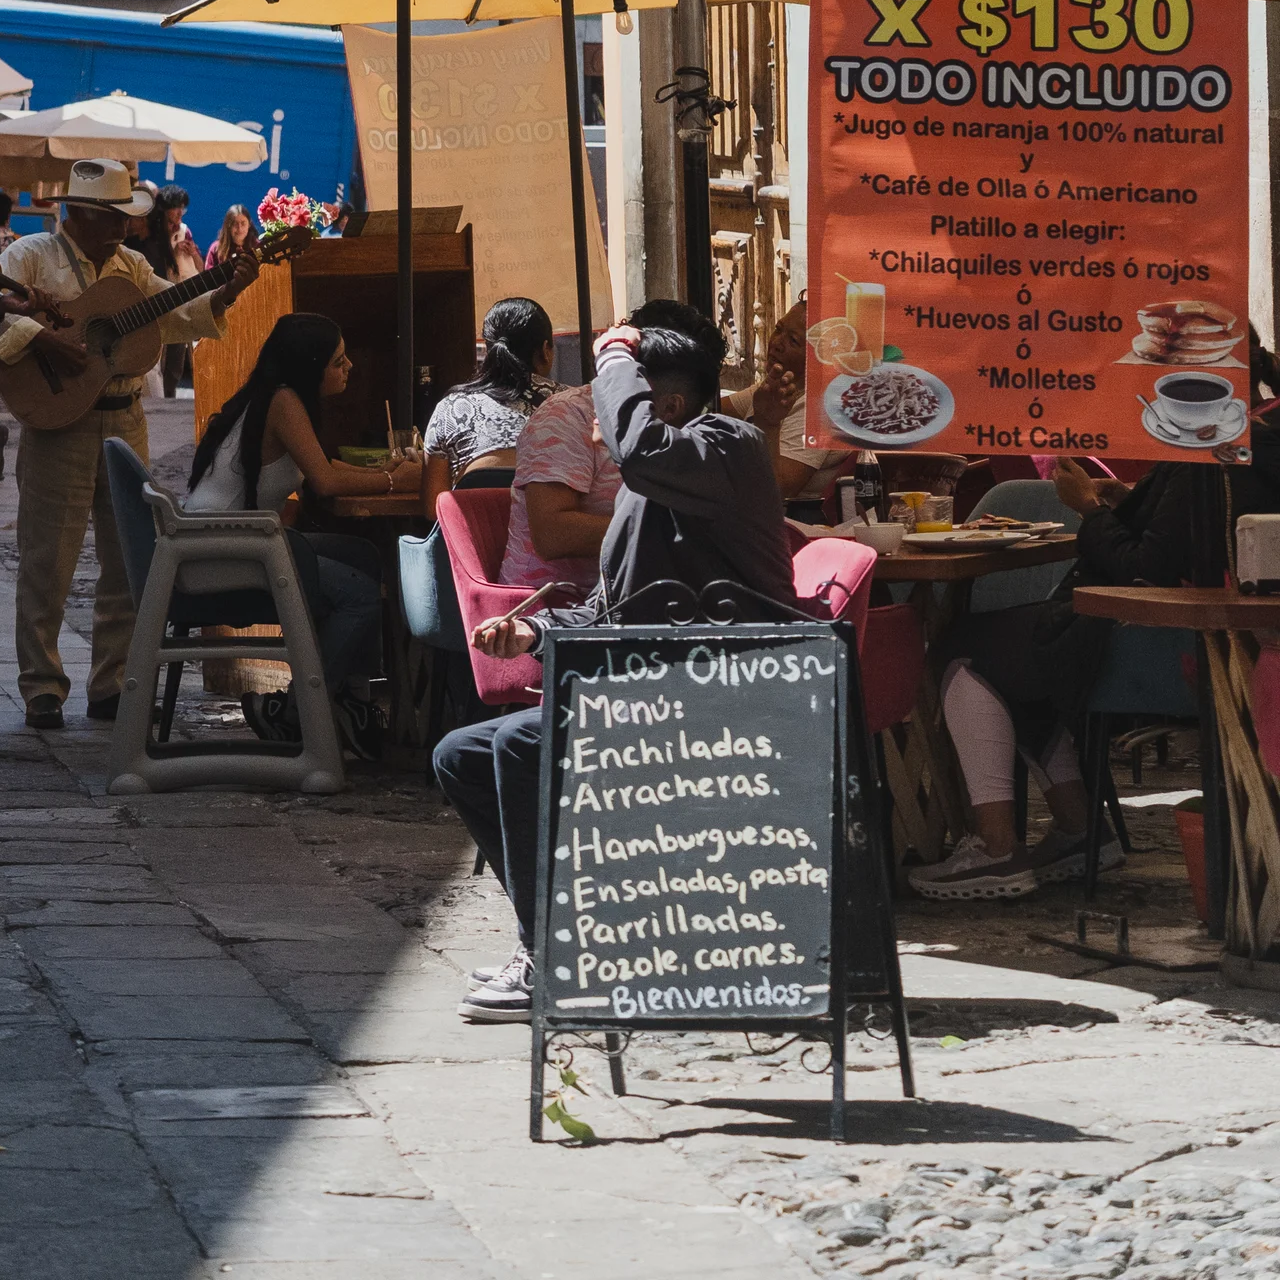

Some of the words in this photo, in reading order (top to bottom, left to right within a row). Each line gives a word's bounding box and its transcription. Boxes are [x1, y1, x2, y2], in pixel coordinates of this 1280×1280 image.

[827, 55, 976, 103] TODO
[983, 61, 1232, 112] INCLUIDO
[913, 114, 945, 136] de
[952, 119, 1050, 145] naranja
[1057, 121, 1126, 145] 100%
[1133, 123, 1225, 145] natural
[1019, 153, 1035, 172] y
[938, 176, 970, 197] de
[976, 177, 1027, 199] Olla
[1034, 179, 1050, 200] ó
[1057, 180, 1198, 205] Americano
[930, 215, 1017, 239] Platillo
[1023, 222, 1039, 240] a
[1046, 219, 1125, 246] elegir:
[1029, 256, 1115, 278] verdes
[1123, 258, 1139, 280] ó
[1146, 263, 1210, 286] rojos
[1016, 284, 1032, 305] ó
[1018, 310, 1040, 331] al
[1048, 309, 1123, 333] Gusto
[1015, 339, 1031, 360] ó
[1028, 397, 1044, 419] ó
[1028, 427, 1109, 450] Cakes
[578, 693, 684, 729] Menú:
[573, 726, 782, 774] Enchiladas.
[572, 772, 780, 814] Arracheras.
[575, 904, 786, 948] Parrilladas.
[577, 946, 688, 989] Pozole,
